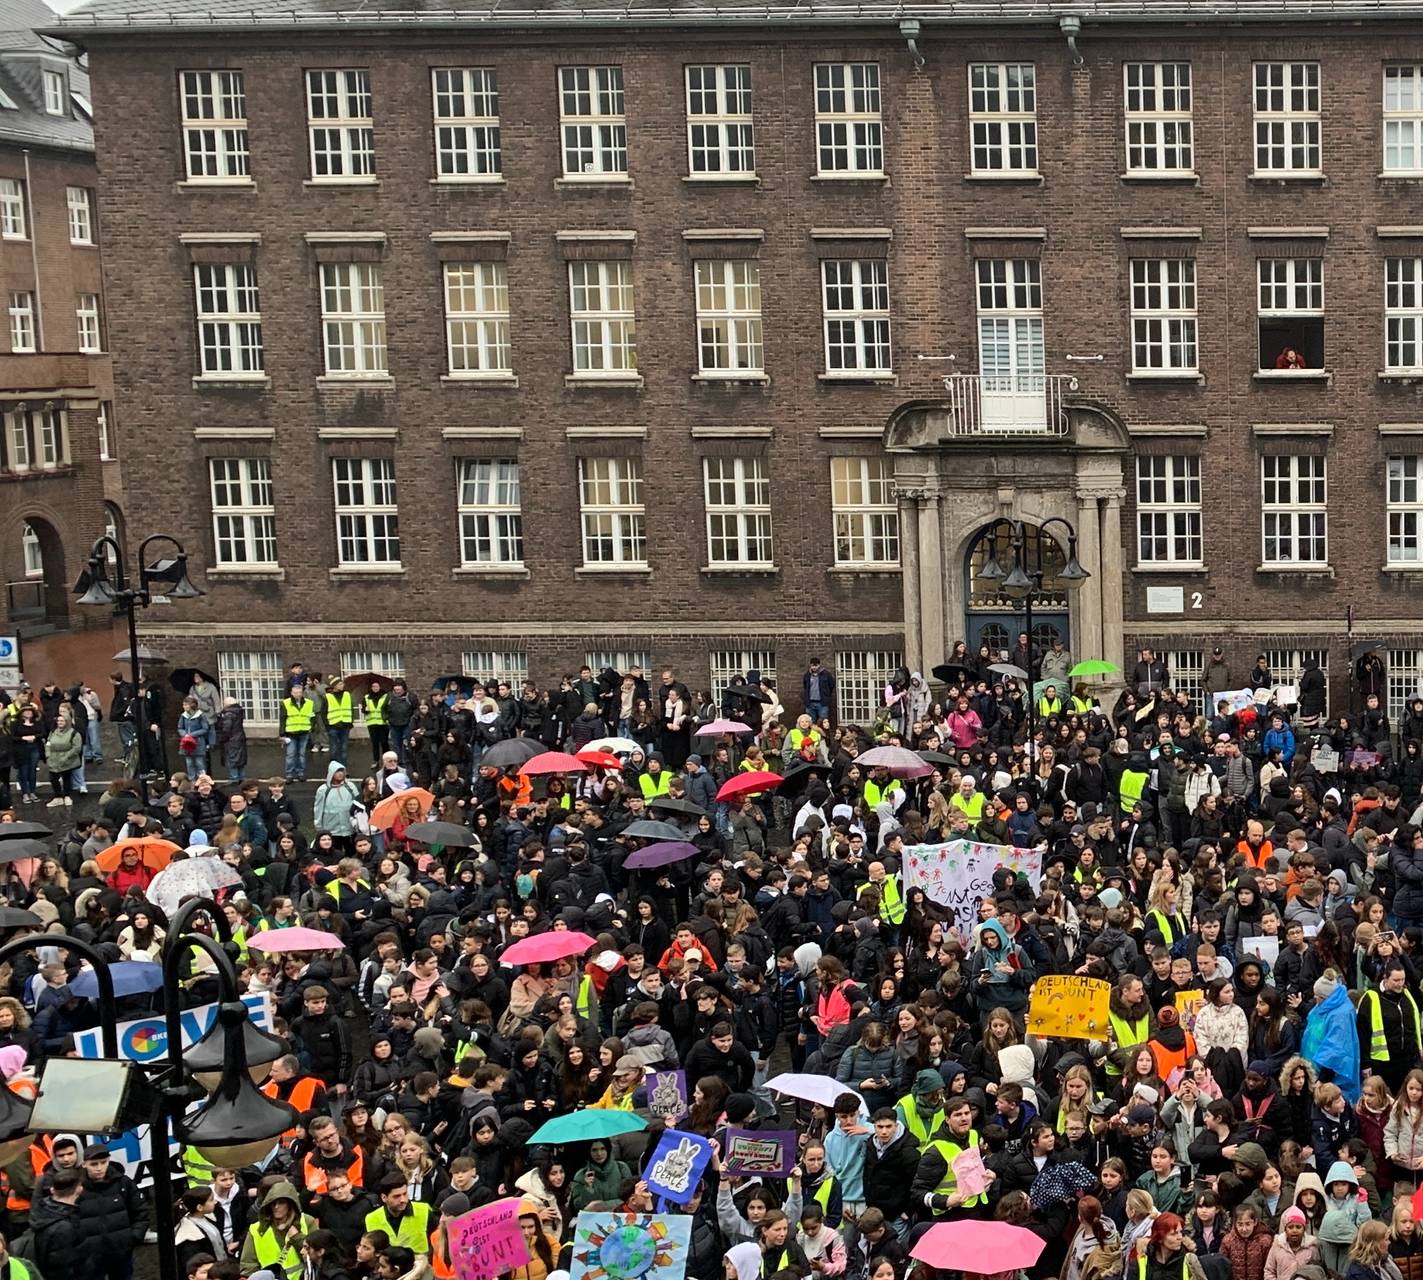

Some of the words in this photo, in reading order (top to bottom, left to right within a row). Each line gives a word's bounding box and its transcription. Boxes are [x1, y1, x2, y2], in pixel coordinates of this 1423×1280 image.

[1191, 591, 1203, 609] 2
[1040, 976, 1110, 991] DEUTSCHLAND
[652, 1103, 682, 1114] PEACE
[655, 1164, 684, 1189] PEACE
[462, 1209, 513, 1240] DEUTSCHLAND
